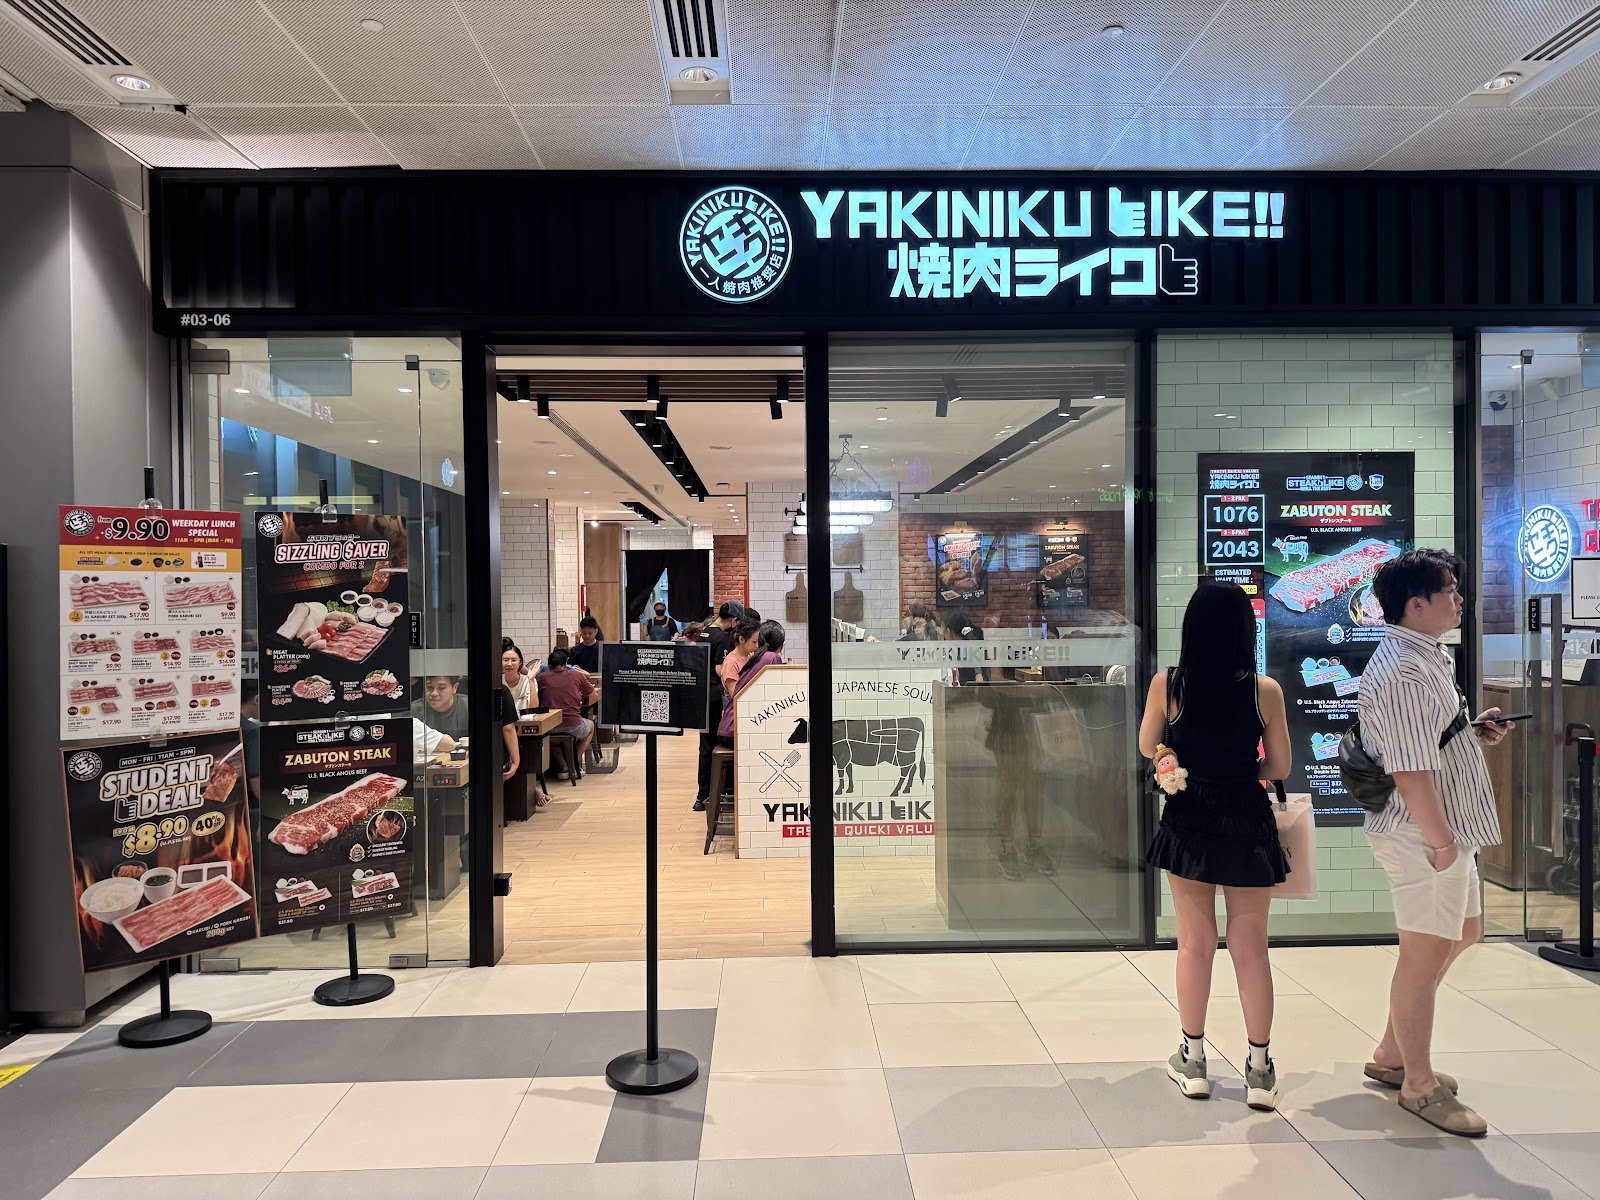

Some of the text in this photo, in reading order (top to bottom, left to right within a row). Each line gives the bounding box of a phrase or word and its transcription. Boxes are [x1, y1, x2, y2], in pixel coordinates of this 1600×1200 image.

[800, 186, 1285, 239] YAKINIKU LIKE!!
[686, 191, 744, 268] YAKINIKU
[888, 241, 1158, 298] 焼肉ライク
[180, 313, 232, 327] #03-06
[1213, 506, 1259, 523] 1076
[1280, 504, 1393, 518] ZABUTON STEAK
[97, 515, 170, 542] from $9.90
[171, 519, 236, 529] WEEKDAY LUNCH
[187, 529, 219, 537] SPECIAL
[276, 540, 388, 562] SIZZLING $AVER
[1212, 540, 1260, 558] 2043
[303, 561, 365, 571] COMBO FOR 2
[749, 690, 807, 727] YAKINIKU
[836, 681, 899, 696] JAPANESE
[298, 732, 344, 741] STEAK LIKE
[158, 752, 175, 760] 11AM
[284, 747, 392, 766] ZABUTON STEAK
[102, 757, 211, 799] STUDENT
[140, 783, 202, 816] DEAL
[196, 814, 221, 832] 40%
[844, 824, 934, 837] QUICK! VALU
[124, 816, 188, 857] $8.90
